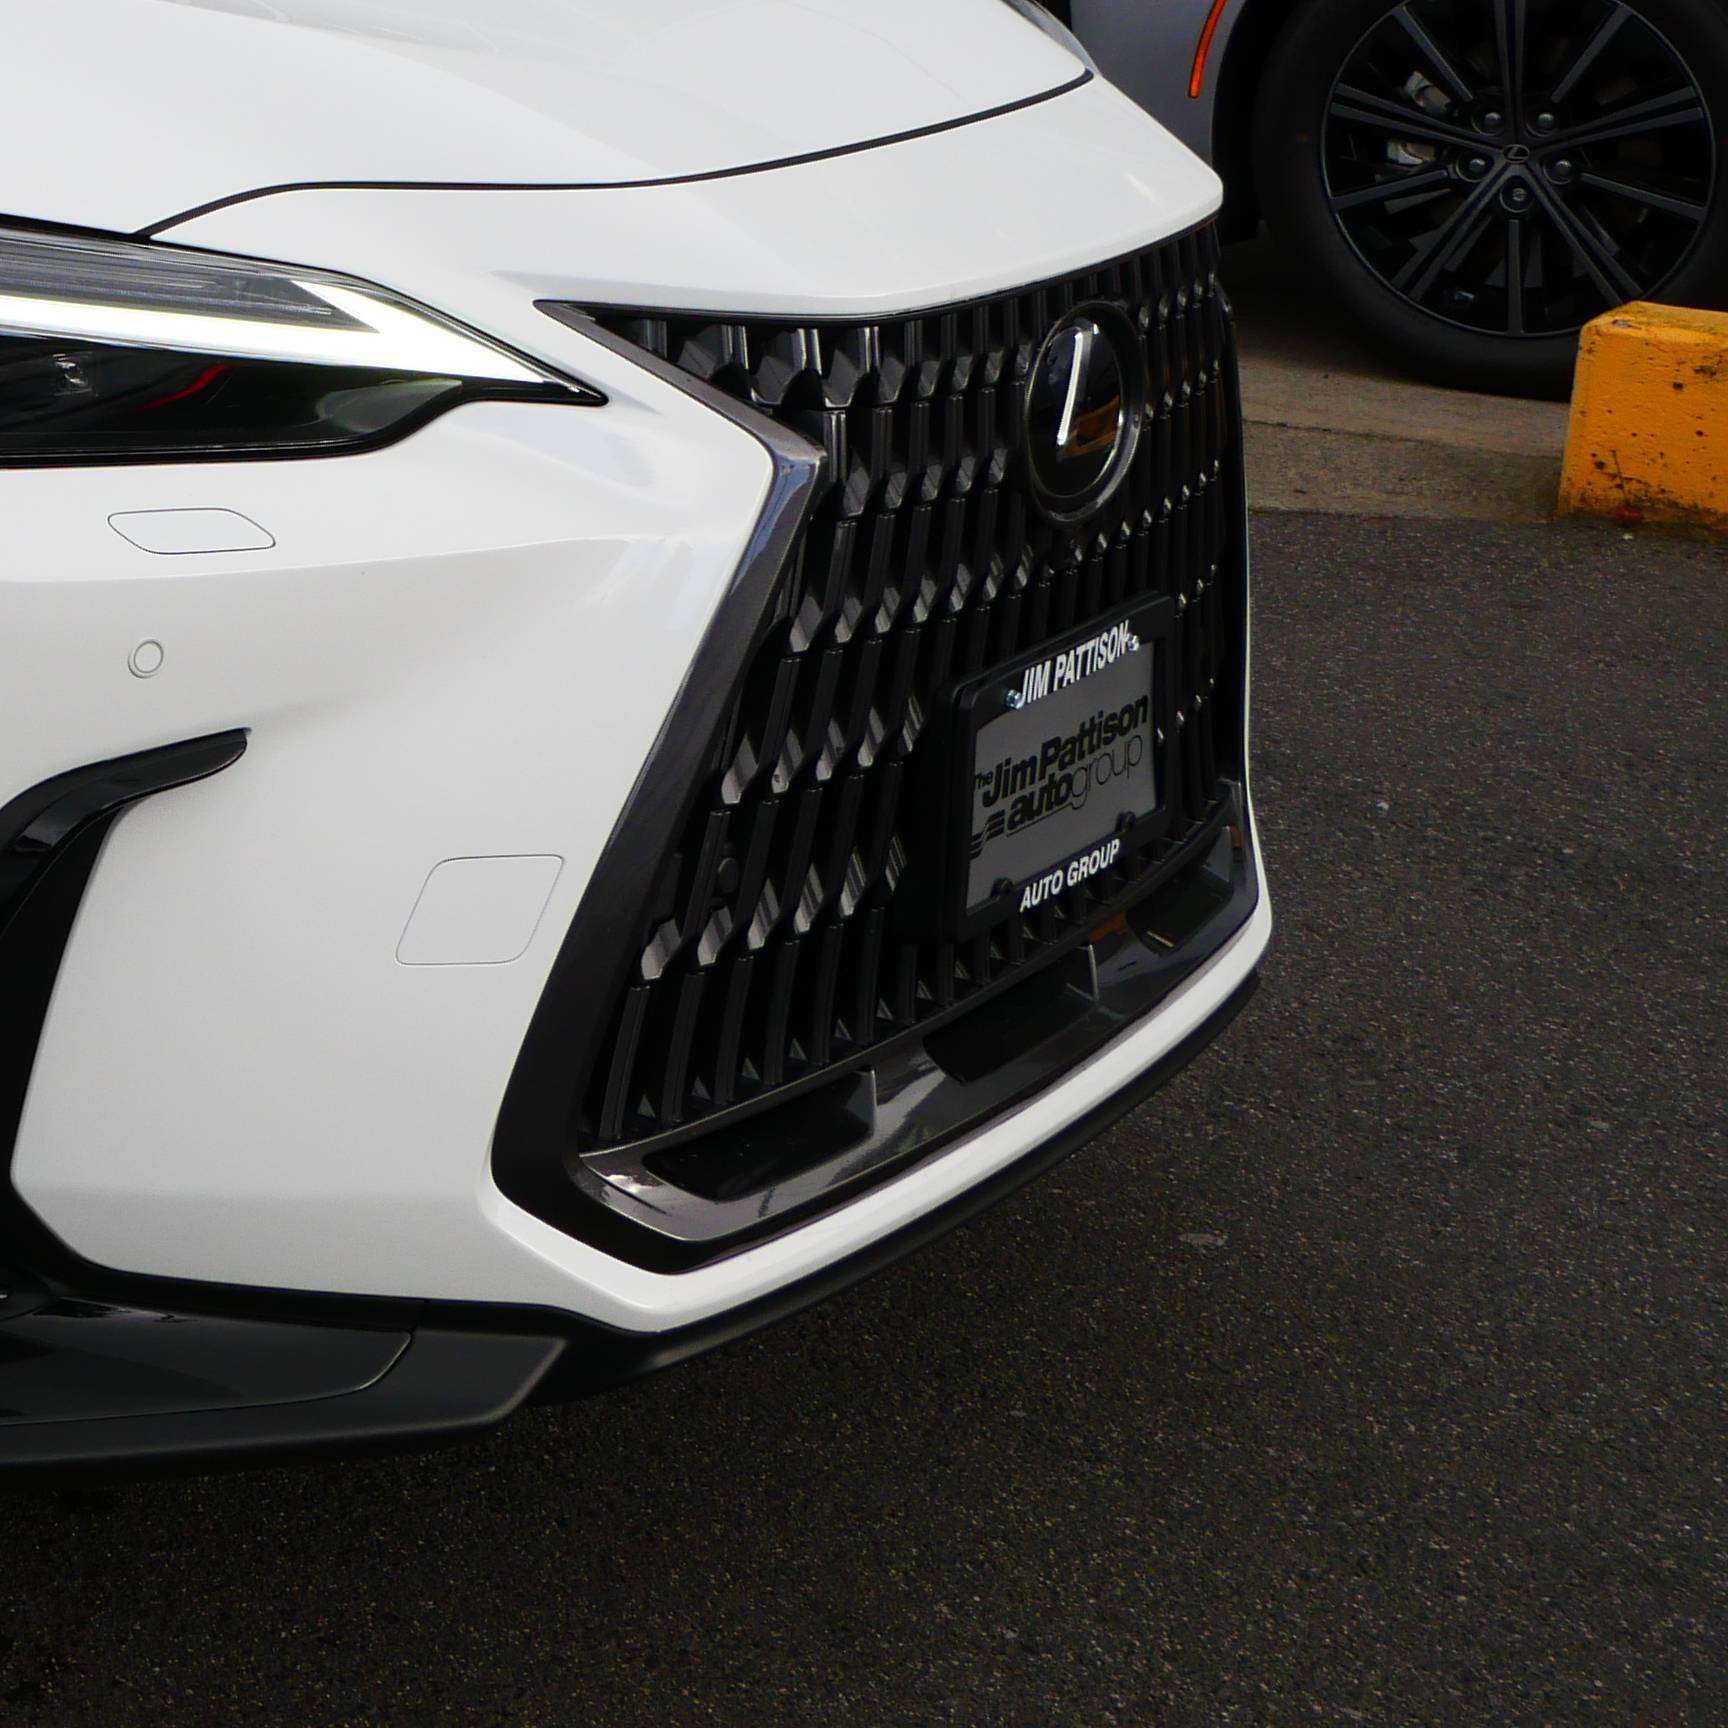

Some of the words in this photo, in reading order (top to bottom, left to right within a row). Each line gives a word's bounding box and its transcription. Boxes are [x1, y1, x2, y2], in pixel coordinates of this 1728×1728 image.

[1017, 660, 1052, 708] JIM
[1053, 619, 1130, 691] PATTISON
[1019, 870, 1064, 912] AUTO
[1067, 838, 1121, 887] GROUP
